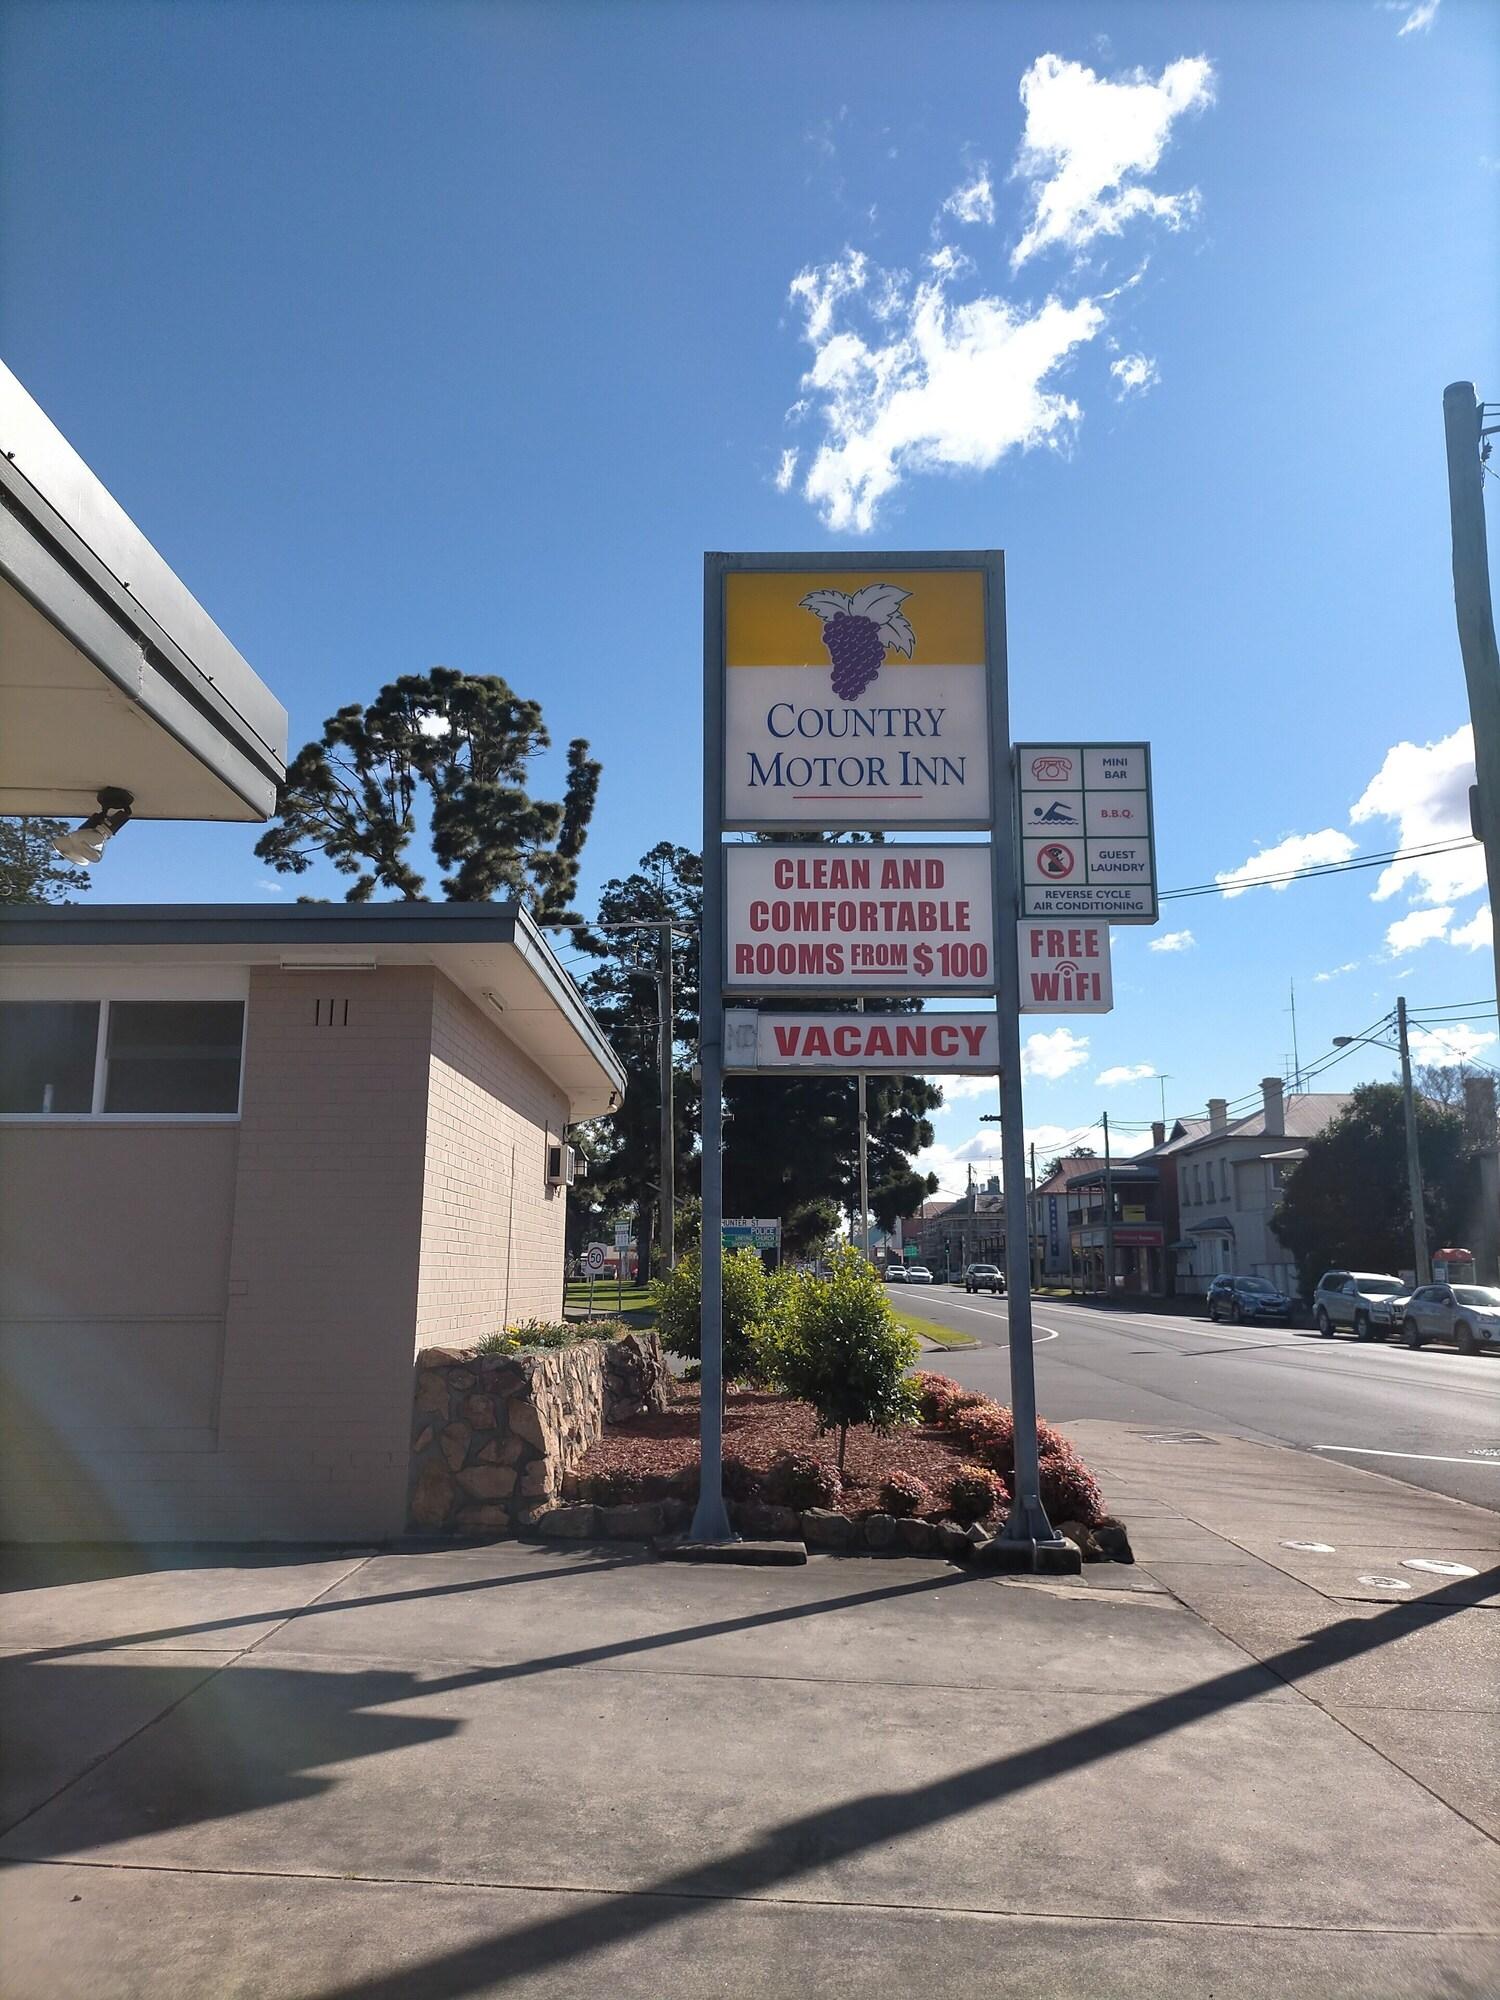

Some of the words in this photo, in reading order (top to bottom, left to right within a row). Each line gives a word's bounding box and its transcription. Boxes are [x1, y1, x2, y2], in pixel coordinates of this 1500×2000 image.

[767, 702, 946, 739] COUNTRY
[1102, 757, 1128, 767] MINI
[747, 753, 890, 787] MOTOR
[899, 751, 967, 786] INN
[1104, 770, 1127, 779] BAR
[1101, 809, 1134, 819] B.B.Q.
[1098, 850, 1136, 860] GUEST
[1090, 863, 1145, 872] LAUNDRY
[774, 858, 870, 890] CLEAN
[880, 858, 945, 890] AND
[1045, 890, 1093, 899] REVERSE
[1095, 890, 1131, 899] CYCLE
[1033, 902, 1054, 911] AIR
[1055, 901, 1144, 911] CONDITIONING
[749, 900, 970, 933] COMFORTABLE
[1030, 929, 1100, 958] FREE
[735, 942, 844, 976] ROOMS
[851, 943, 908, 967] FROM
[913, 942, 988, 978] $100
[773, 1024, 988, 1057] VACANCY
[751, 1227, 775, 1235] POLICE
[590, 1253, 601, 1263] 50
